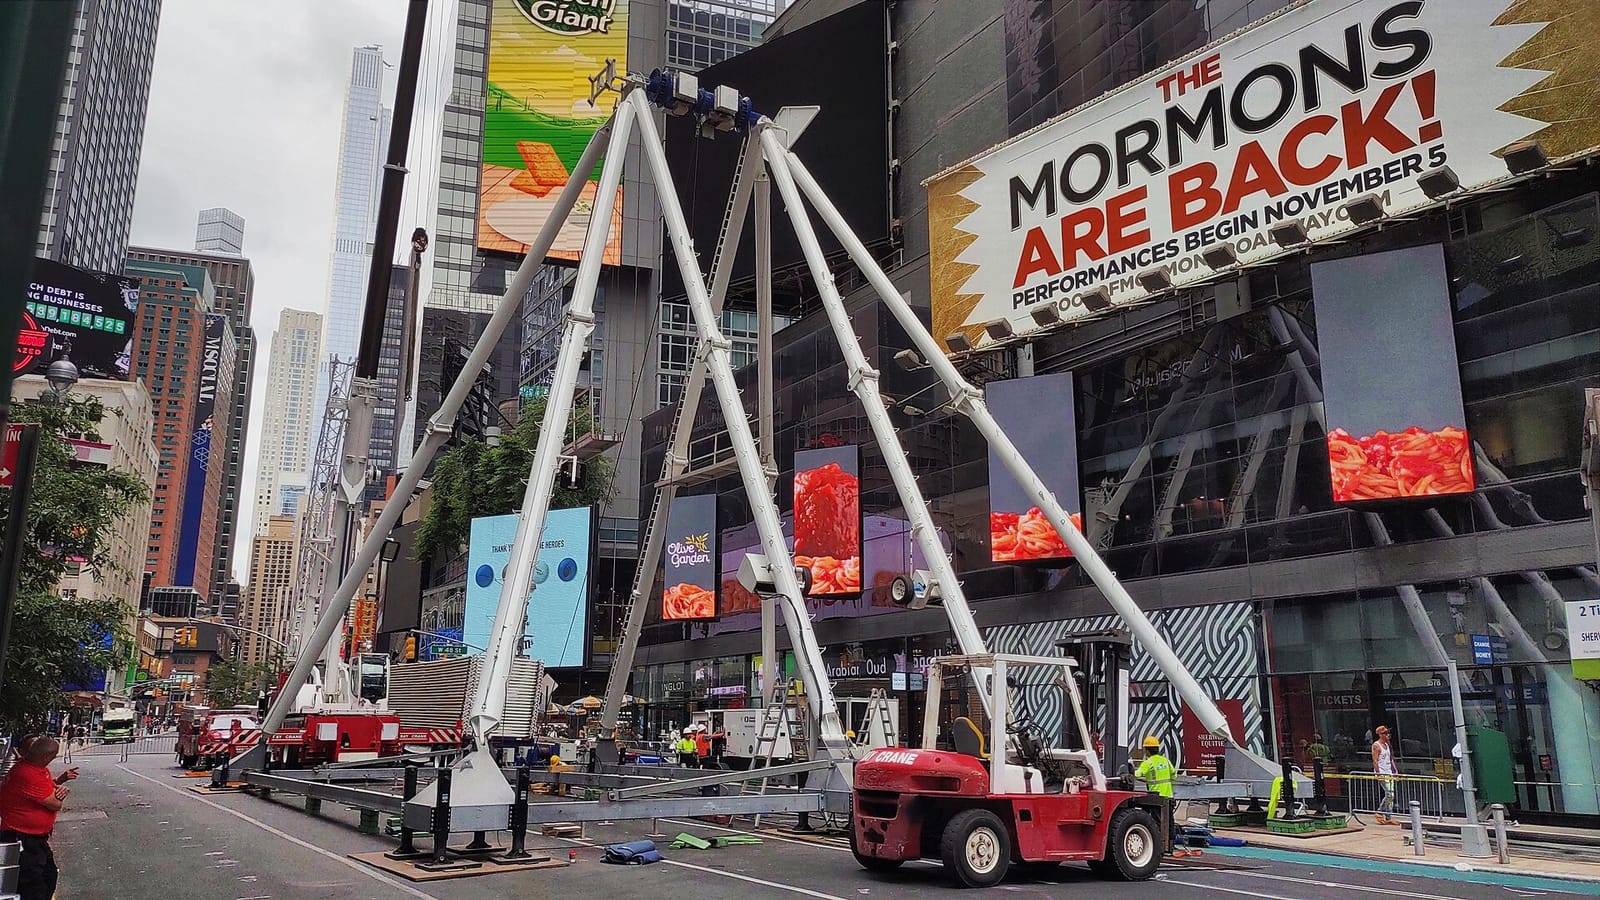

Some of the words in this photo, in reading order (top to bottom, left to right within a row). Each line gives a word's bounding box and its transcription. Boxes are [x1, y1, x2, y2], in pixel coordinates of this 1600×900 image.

[531, 0, 612, 32] Giant
[1156, 53, 1223, 103] THE
[1009, 0, 1433, 232] MORMONS
[1012, 185, 1151, 289] ARE
[1169, 69, 1442, 232] BACK!
[1012, 238, 1179, 309] PERFORMANCES
[1184, 210, 1258, 252] BEGIN
[1264, 153, 1424, 224] NOVEMBER
[1428, 144, 1447, 168] 5
[47, 286, 73, 298] DEBT
[75, 292, 85, 300] IS
[43, 295, 103, 313] BUSINESSES
[668, 542, 695, 555] Olive
[671, 551, 711, 568] Garden
[1579, 606, 1587, 617] 2
[866, 657, 887, 675] Oud
[875, 751, 918, 766] CRANE
